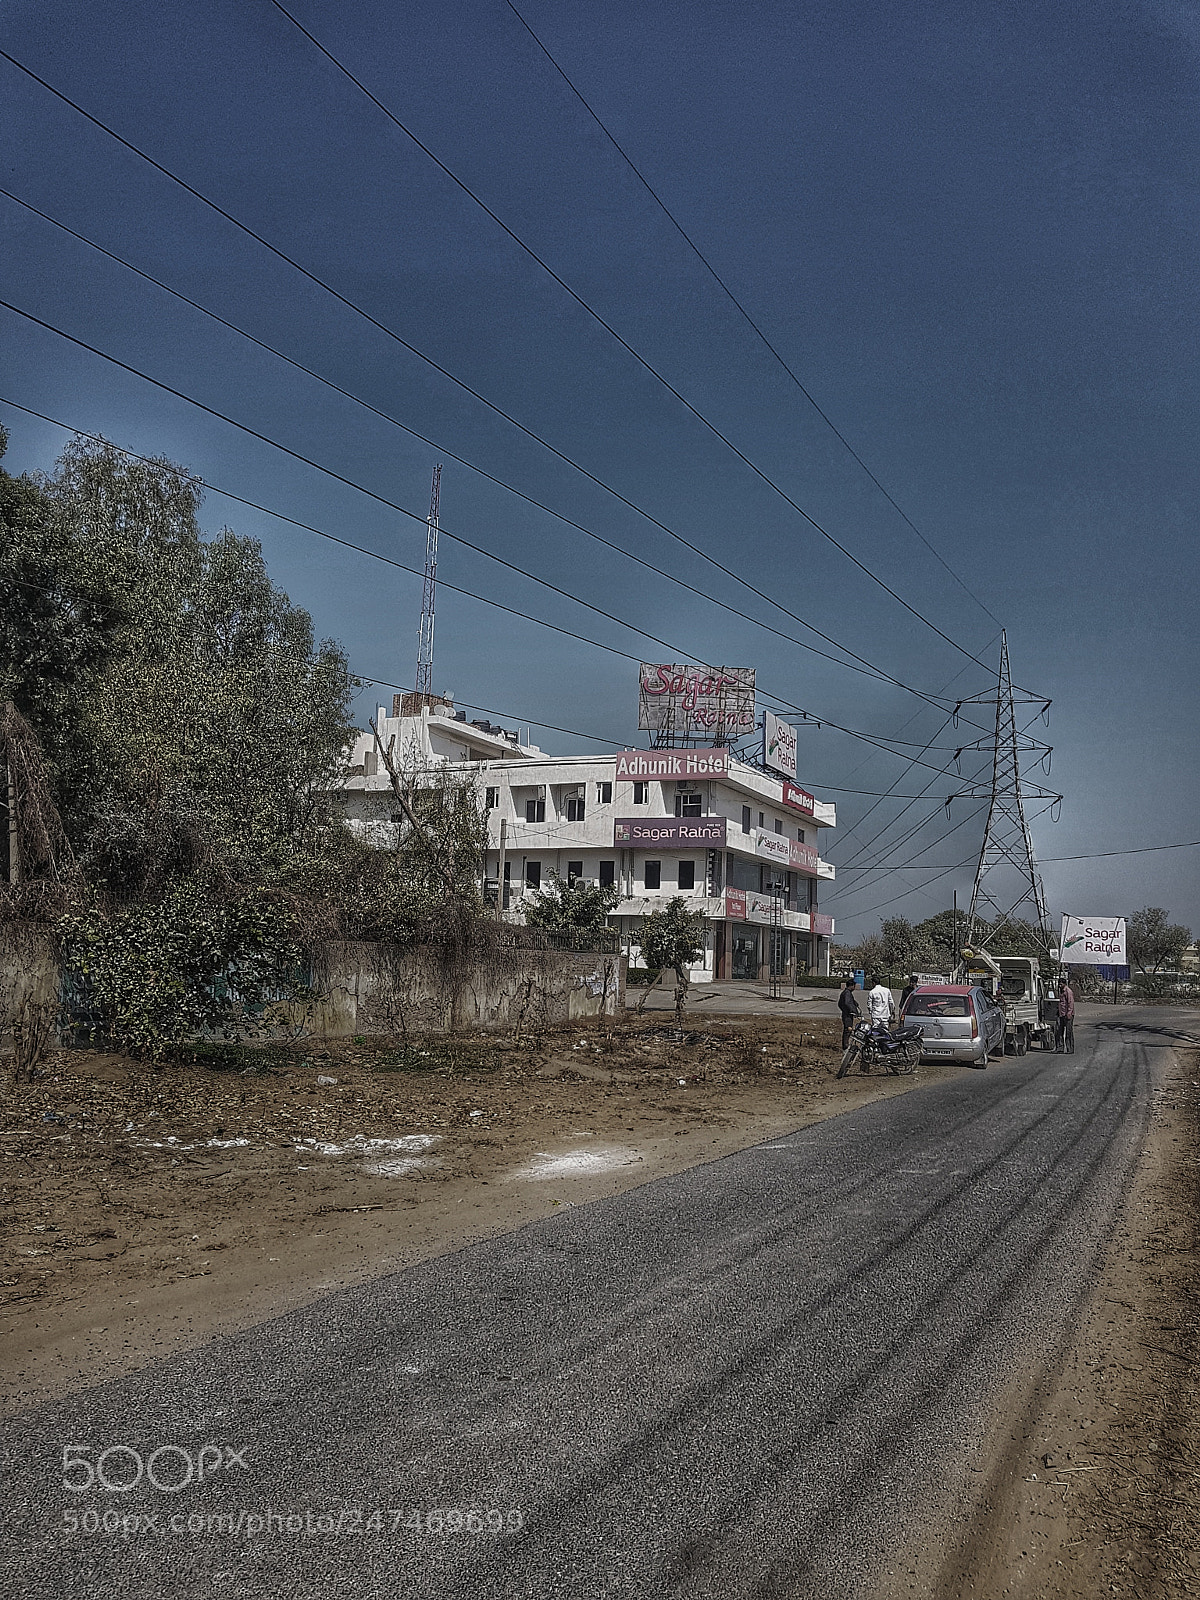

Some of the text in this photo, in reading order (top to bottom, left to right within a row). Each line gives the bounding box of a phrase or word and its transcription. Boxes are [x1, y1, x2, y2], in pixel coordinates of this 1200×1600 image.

[643, 665, 739, 710] Sagar
[693, 708, 754, 727] Ratna
[777, 726, 797, 750] Sagar
[616, 753, 728, 775] Adhunik Hotel
[777, 748, 796, 771] Ratna
[632, 826, 722, 841] Sagar Ratna
[764, 837, 789, 855] Sagar Ratna
[1085, 927, 1122, 941] Sagar
[1085, 941, 1121, 953] Ratna
